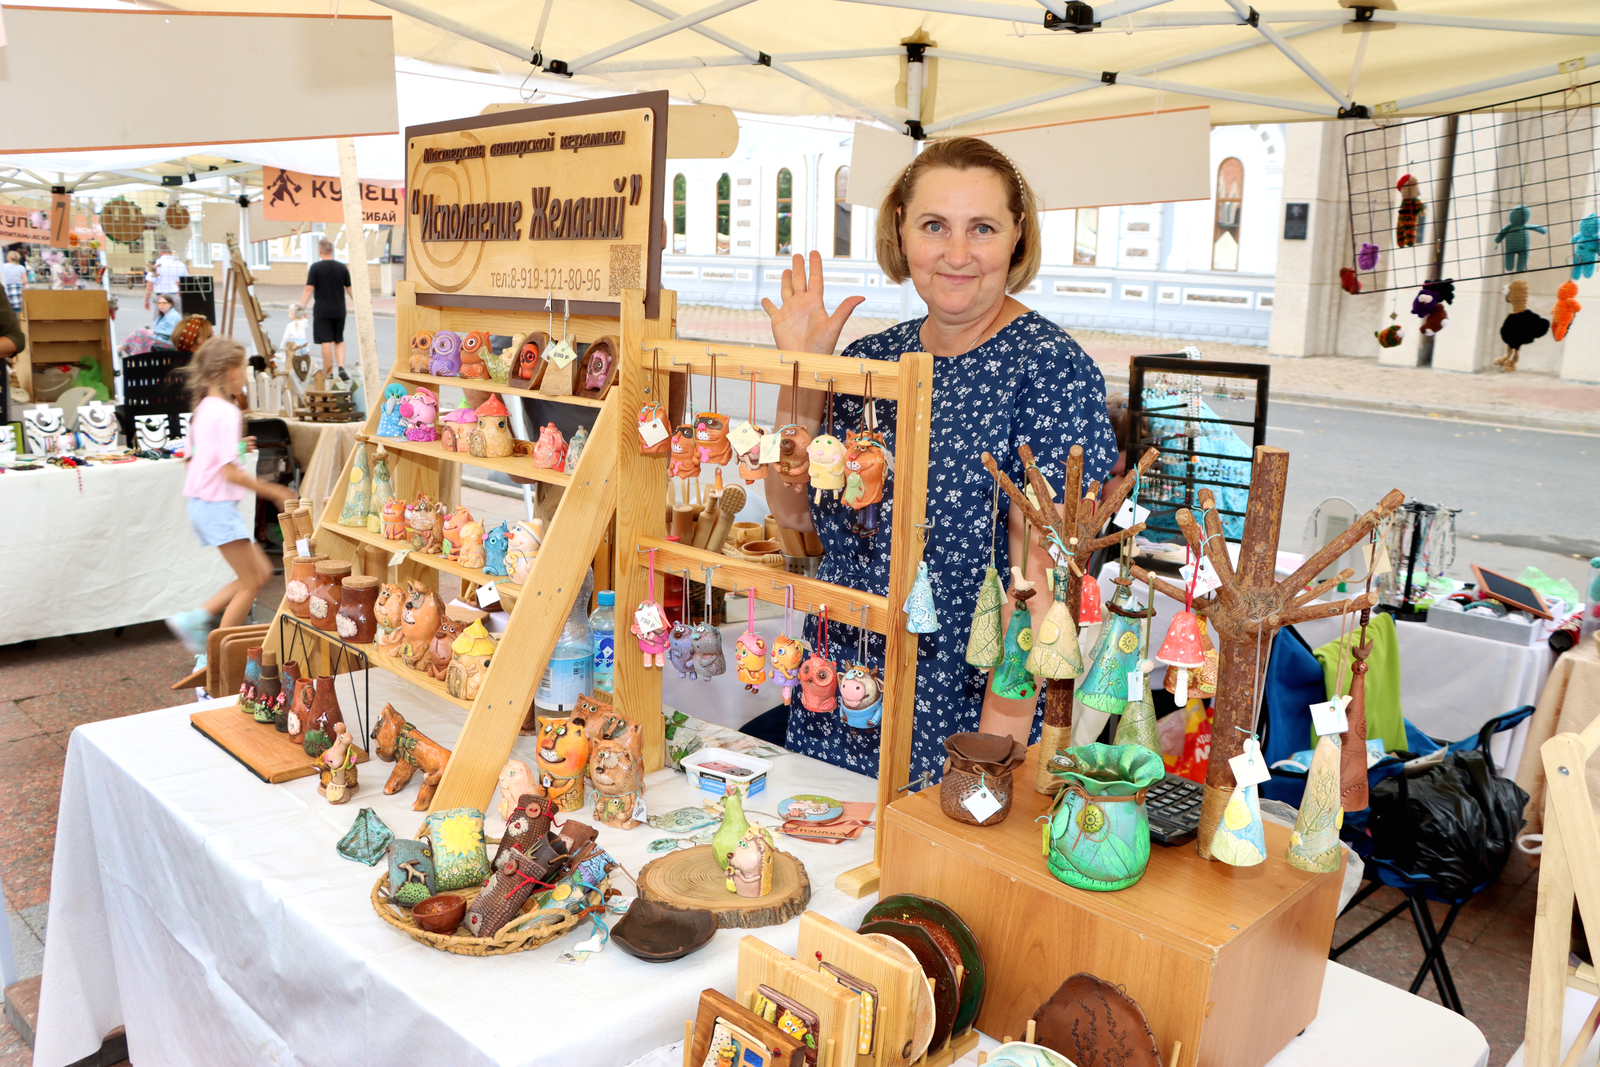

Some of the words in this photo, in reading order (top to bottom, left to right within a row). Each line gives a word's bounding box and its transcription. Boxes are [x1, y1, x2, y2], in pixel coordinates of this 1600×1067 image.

[423, 144, 485, 164] Мастерская
[490, 132, 555, 158] авторской
[560, 130, 626, 153] керамики
[312, 179, 398, 205] КУЕЦ
[490, 267, 601, 291] тел:8-919-121-80-96
